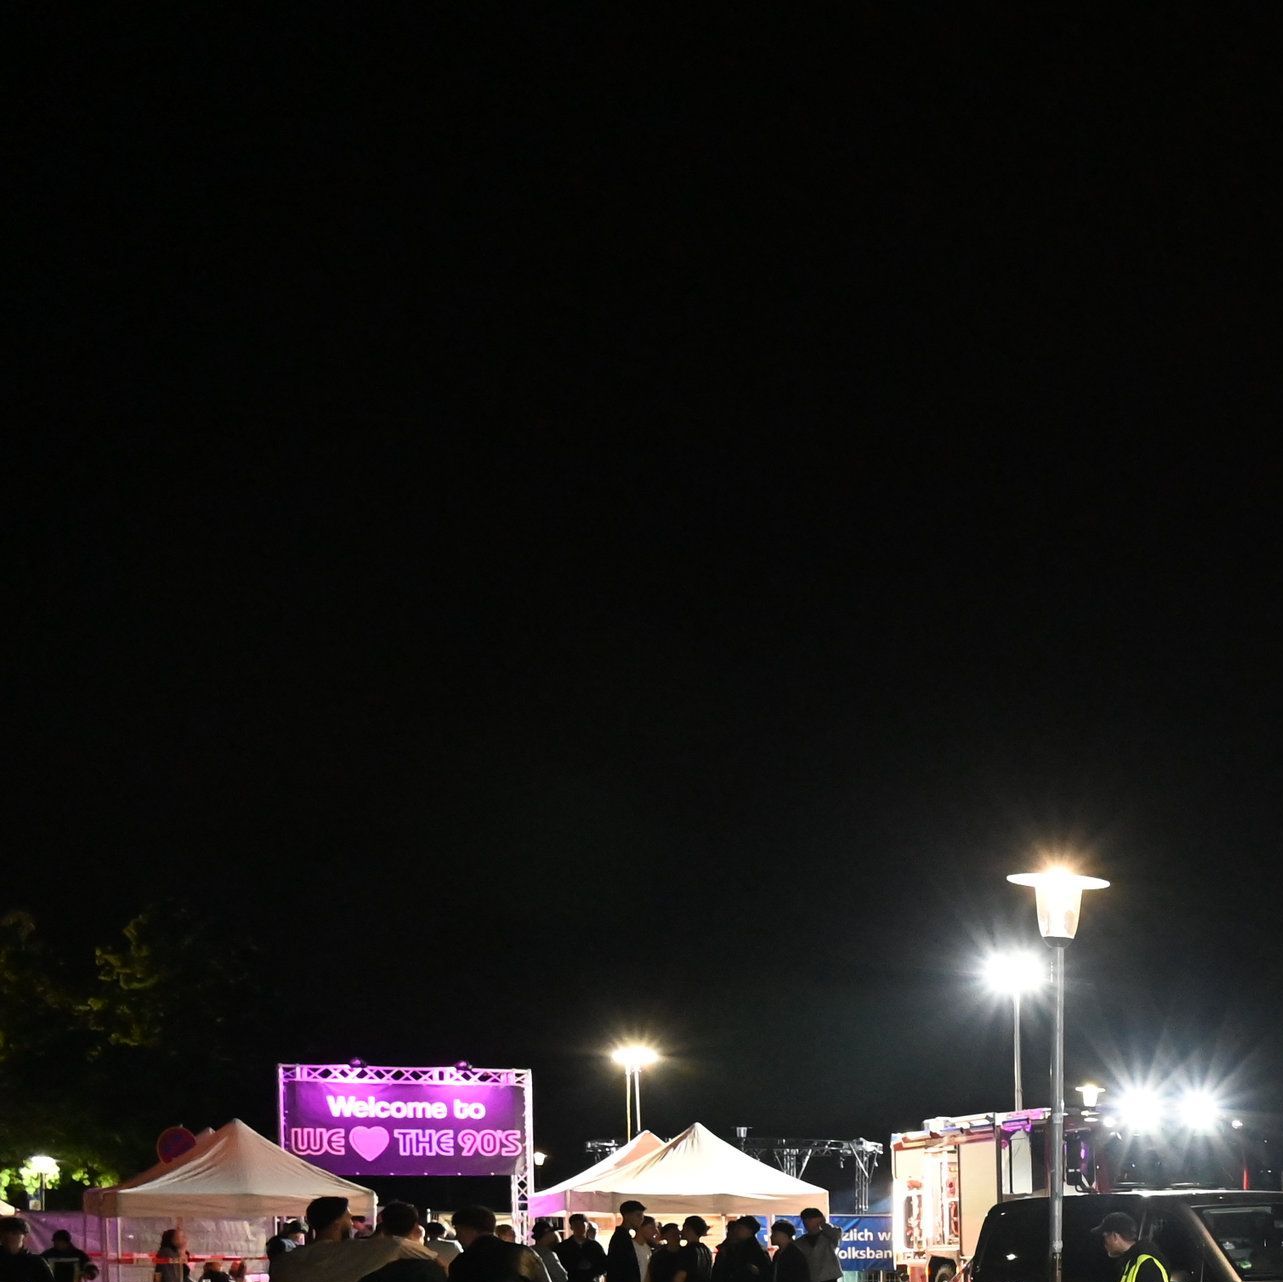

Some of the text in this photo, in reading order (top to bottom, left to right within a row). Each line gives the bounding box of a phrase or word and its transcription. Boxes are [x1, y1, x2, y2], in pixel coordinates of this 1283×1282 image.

[326, 1095, 486, 1120] Welcome to
[291, 1127, 346, 1156] WE
[393, 1128, 455, 1157] THE
[841, 1228, 873, 1242] zlich
